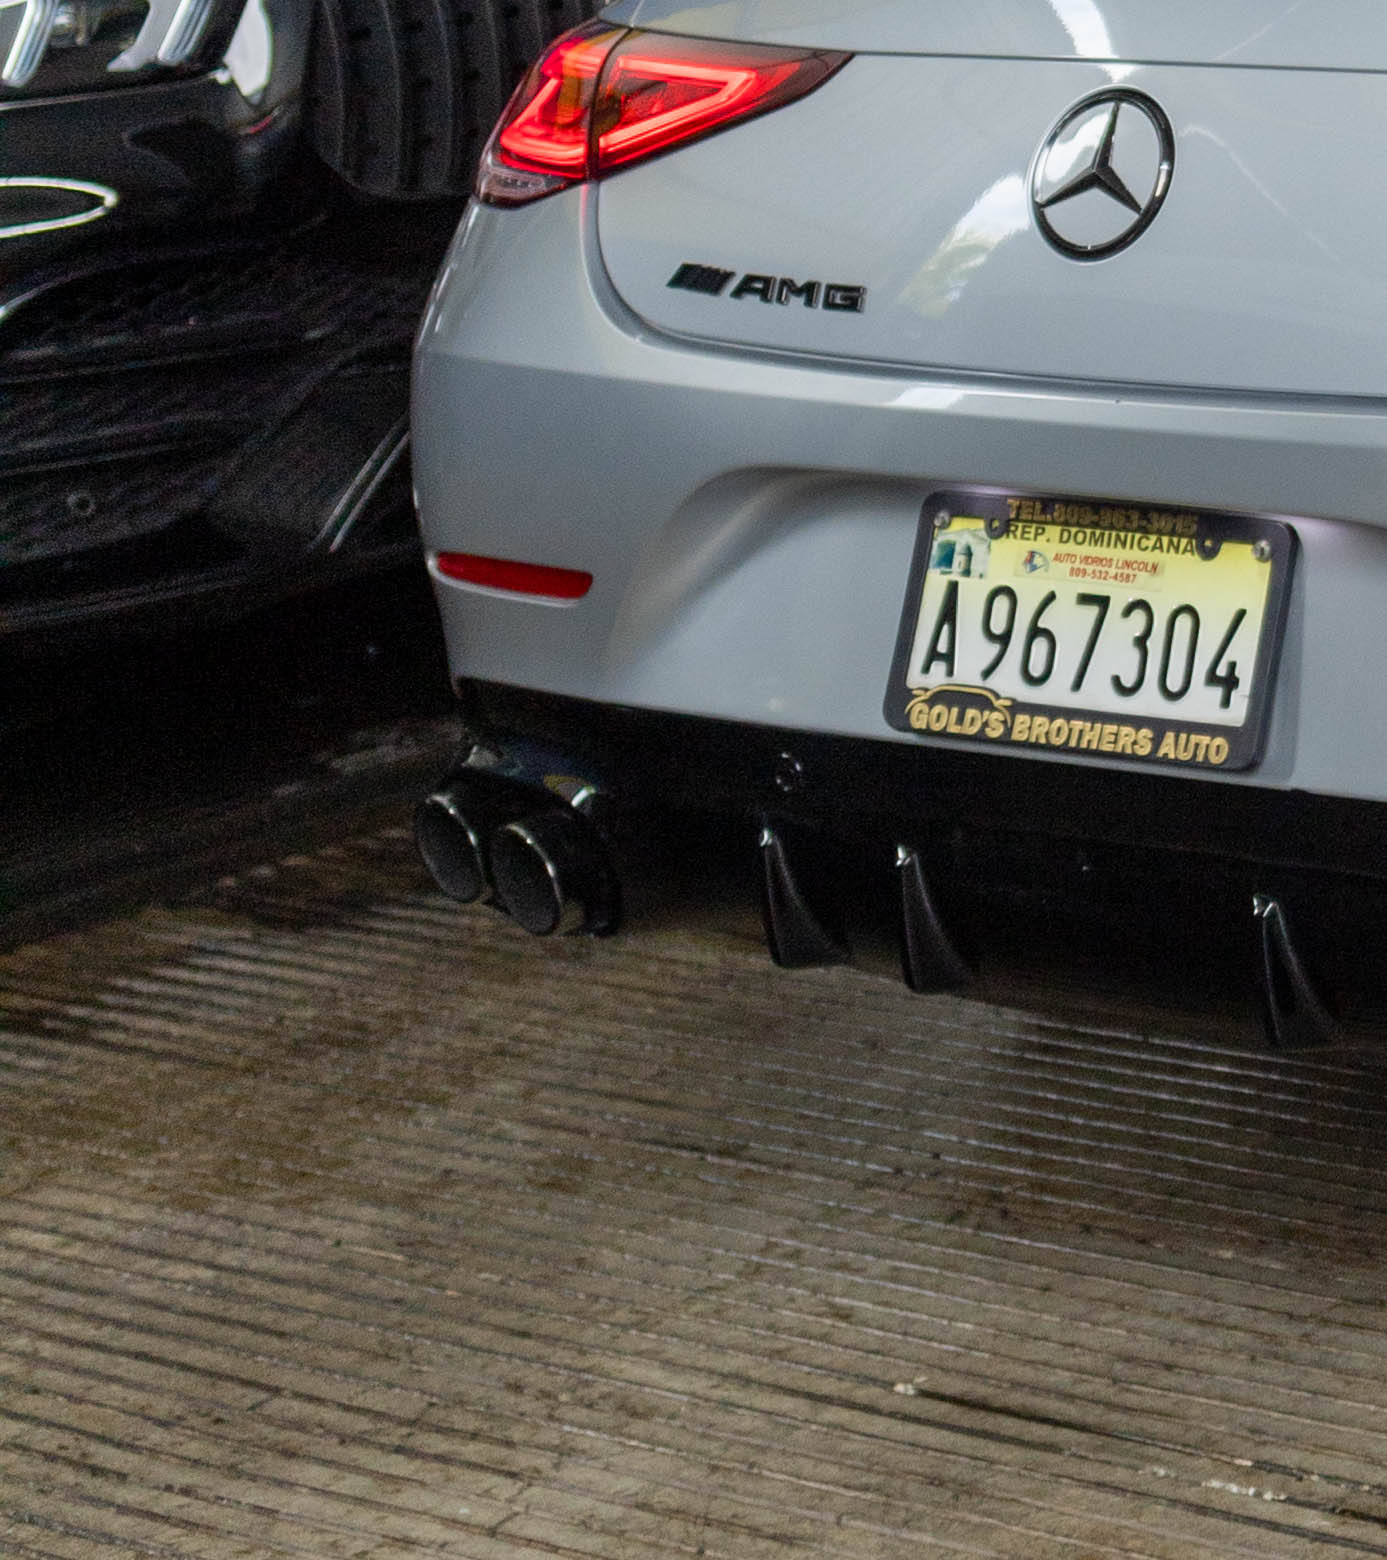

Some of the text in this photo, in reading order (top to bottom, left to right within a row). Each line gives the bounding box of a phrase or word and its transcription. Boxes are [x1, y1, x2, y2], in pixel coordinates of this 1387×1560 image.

[730, 272, 867, 313] AMG
[1005, 522, 1196, 556] REP. DOMINICANA
[1053, 552, 1158, 574] AUTO VIDRIOS LINCOLN
[1069, 567, 1137, 584] 809-532-4587
[920, 580, 1248, 710] A967304
[909, 704, 1230, 766] GOLD'S BROTHERS AUTO
